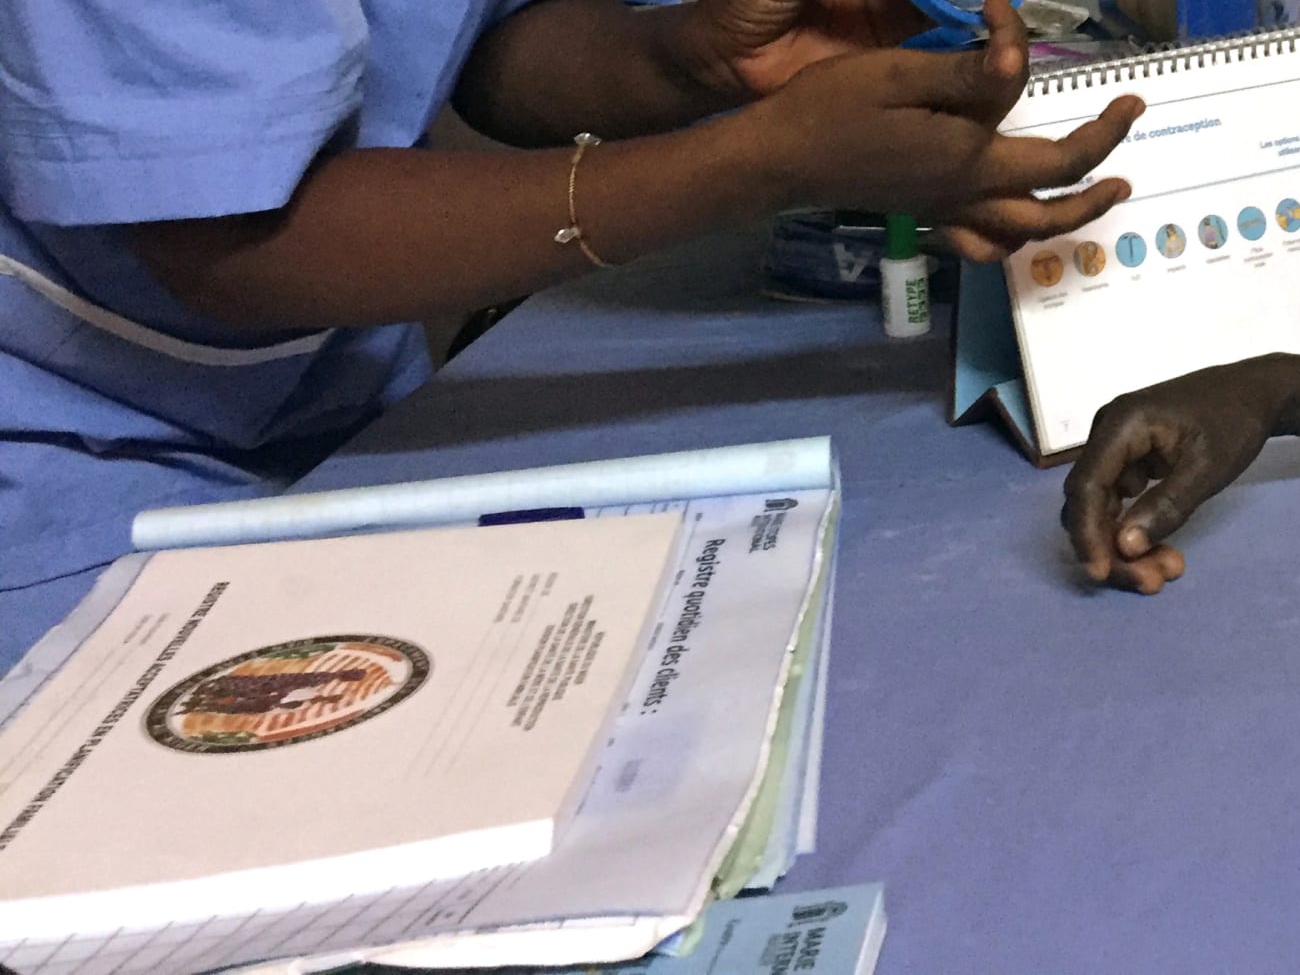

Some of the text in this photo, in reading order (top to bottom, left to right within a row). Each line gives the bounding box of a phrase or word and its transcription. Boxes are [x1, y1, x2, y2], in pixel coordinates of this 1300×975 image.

[1149, 117, 1222, 139] contraception
[692, 538, 726, 590] Registre
[670, 589, 706, 642] quotidien
[660, 645, 690, 666] des
[643, 666, 679, 707] clients
[91, 725, 114, 737] EN
[793, 926, 827, 972] MARIE
